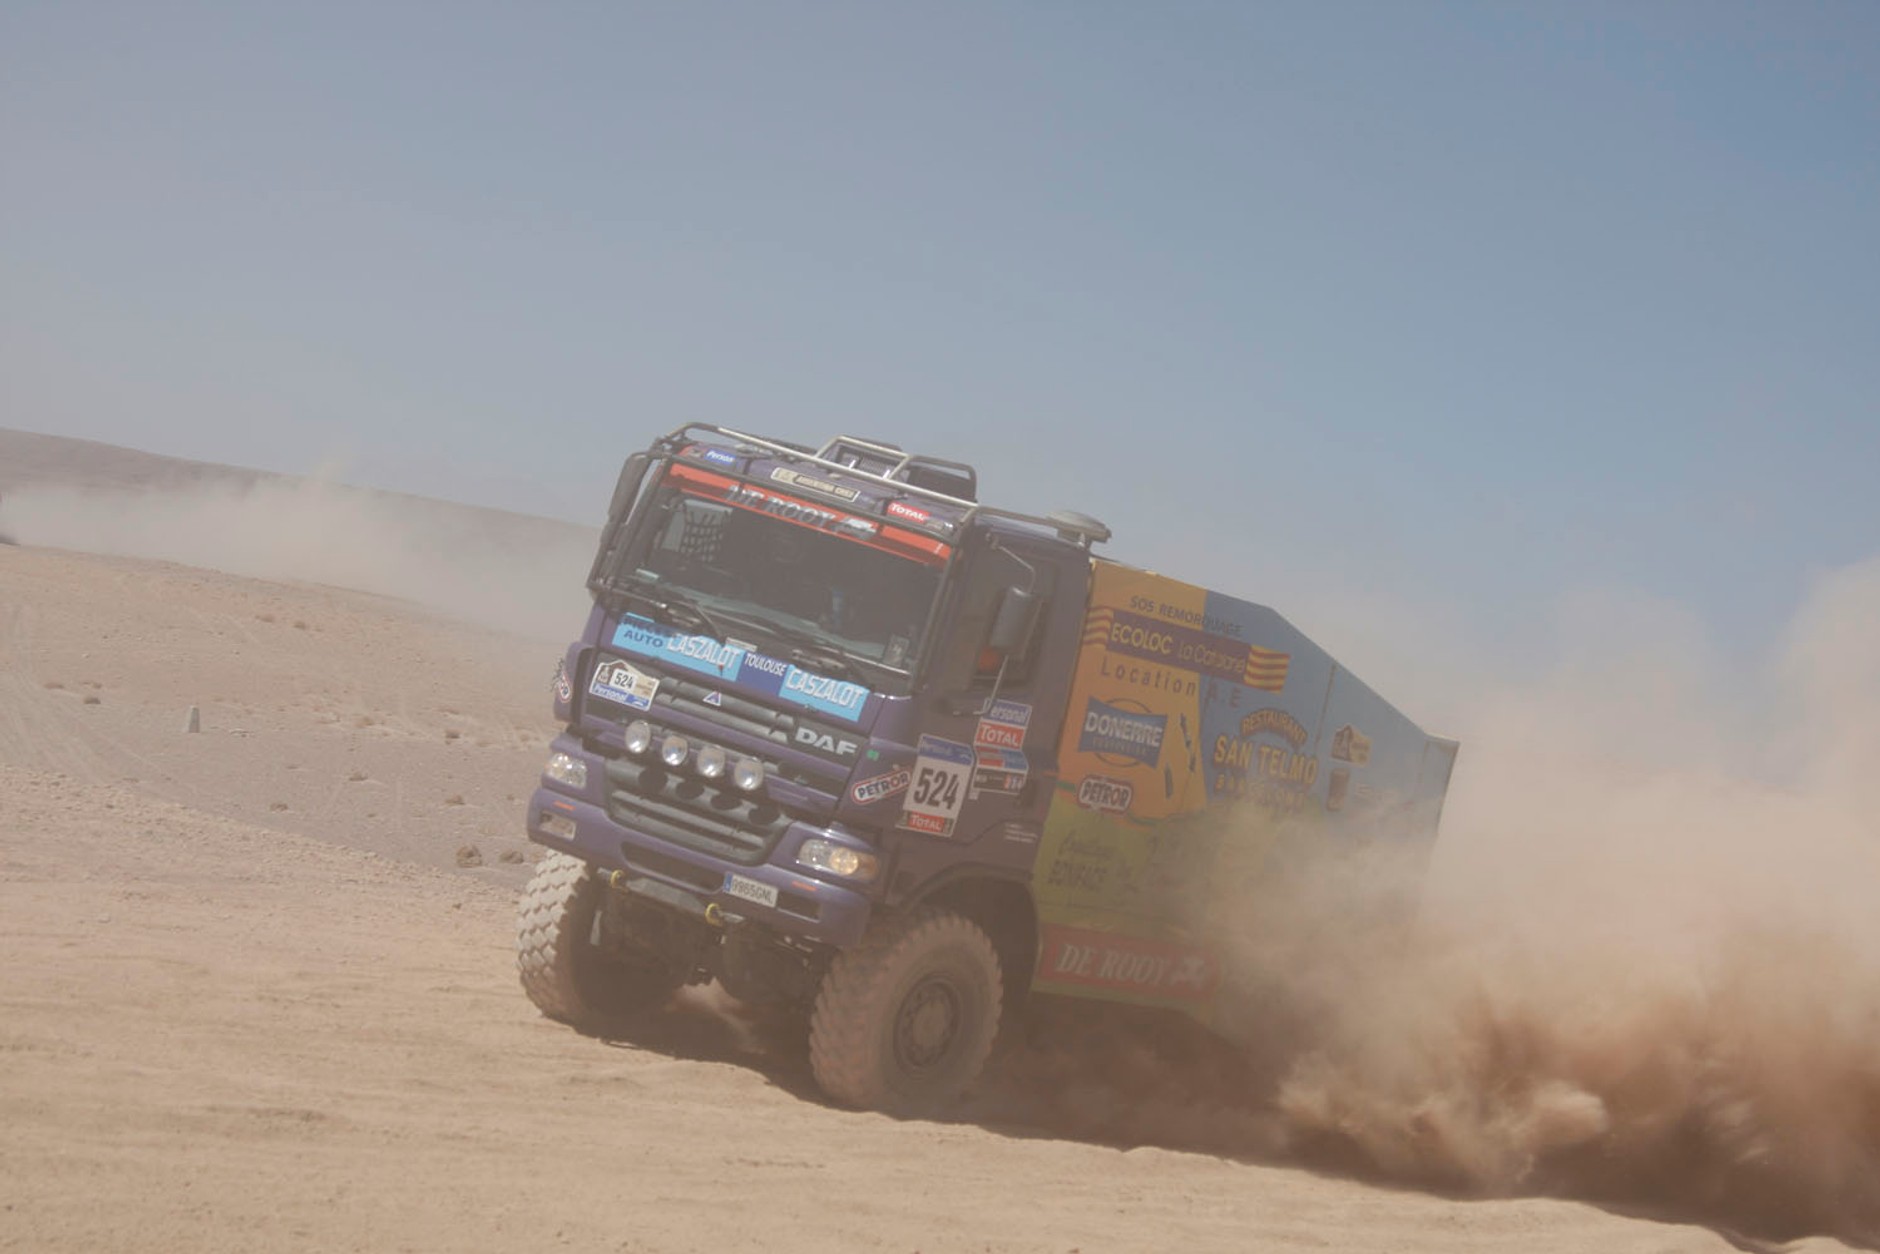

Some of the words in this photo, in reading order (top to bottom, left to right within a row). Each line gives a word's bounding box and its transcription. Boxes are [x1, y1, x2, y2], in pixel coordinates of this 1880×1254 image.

[891, 502, 926, 521] TOTAL
[1129, 595, 1155, 612] SOS
[623, 629, 664, 648] AUTO
[668, 632, 741, 670] CASZALOT
[1110, 622, 1173, 655] ECOLOC
[614, 672, 634, 690] 524
[745, 651, 788, 677] TOULOUSE
[785, 667, 864, 710] CASZALOT
[1101, 656, 1197, 697] Location
[794, 727, 859, 756] DAF
[979, 724, 1020, 747] TOTAL
[1213, 734, 1250, 770] SAN
[1259, 744, 1318, 785] TELMO
[857, 772, 909, 799] PETROR
[914, 767, 959, 809] 524
[1081, 780, 1130, 808] PETROR
[910, 813, 944, 831] TOTAL
[1055, 943, 1097, 975] DE
